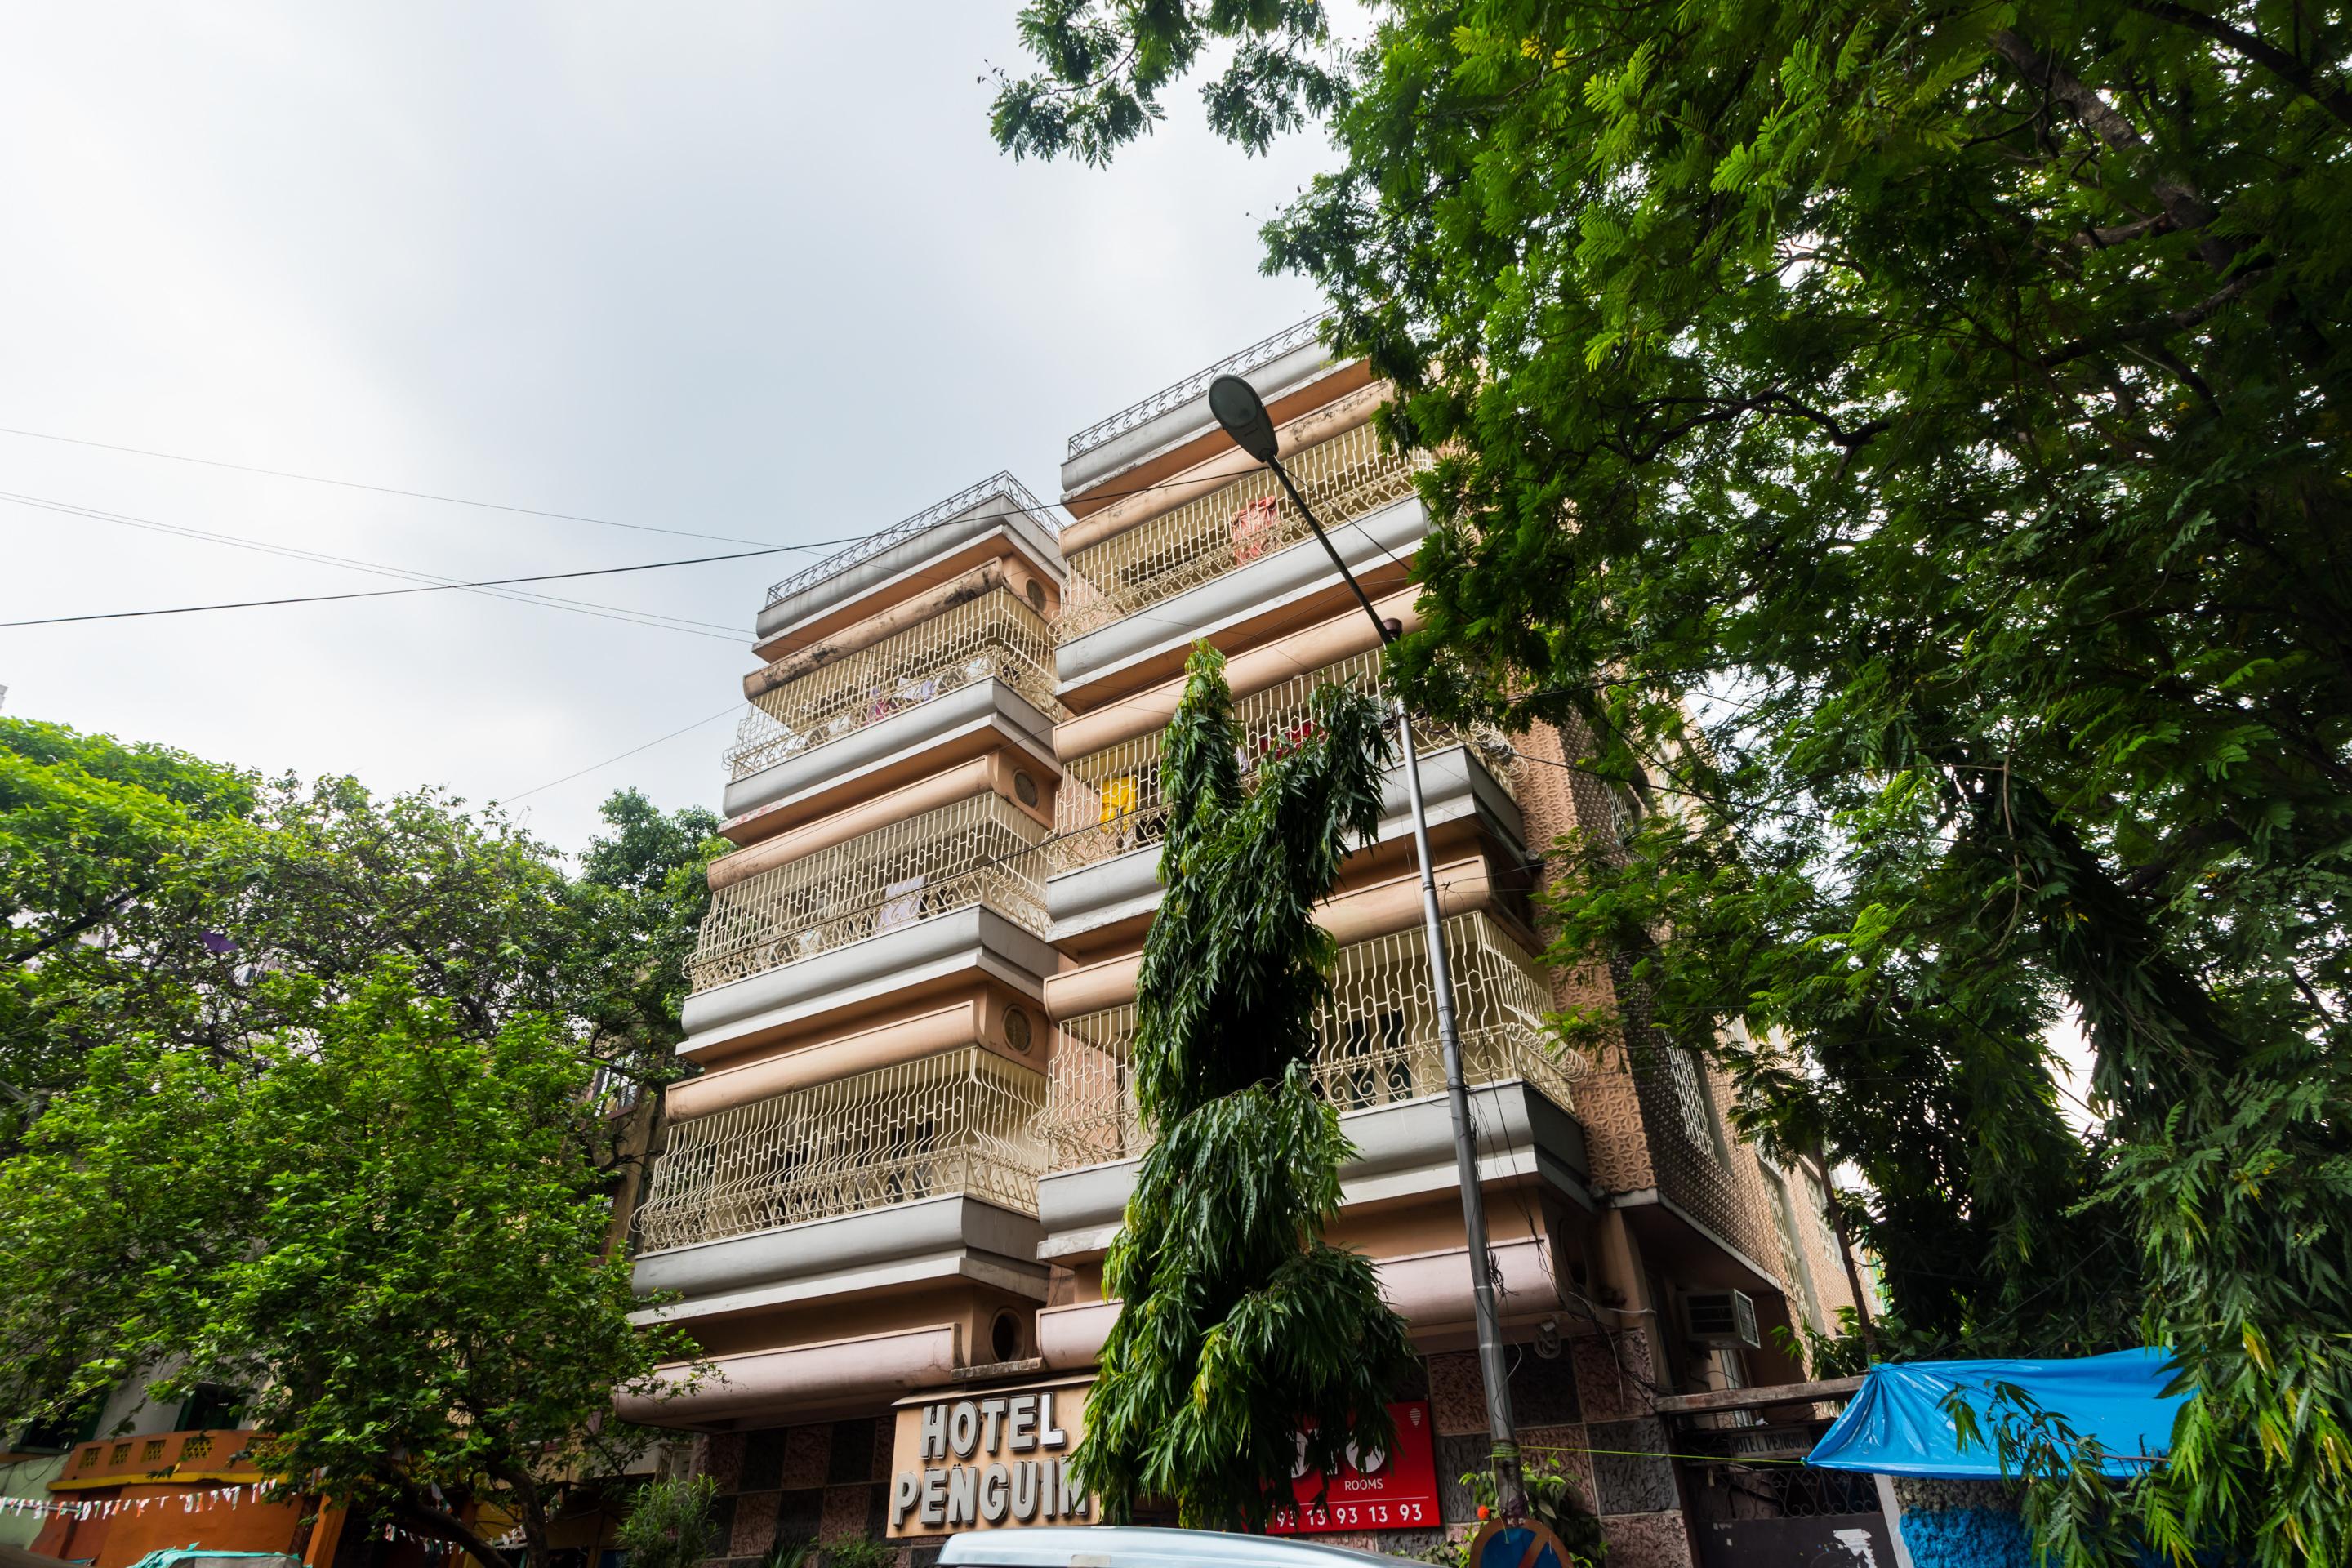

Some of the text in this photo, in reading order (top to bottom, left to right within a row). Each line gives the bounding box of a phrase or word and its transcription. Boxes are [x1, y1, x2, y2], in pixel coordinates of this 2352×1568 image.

[920, 1392, 1065, 1459] HOTEL
[1344, 1478, 1384, 1491] ROOMS
[1307, 1508, 1326, 1526] 13
[1336, 1507, 1358, 1525] 93
[1368, 1506, 1388, 1523] 13
[1399, 1503, 1423, 1521] 93
